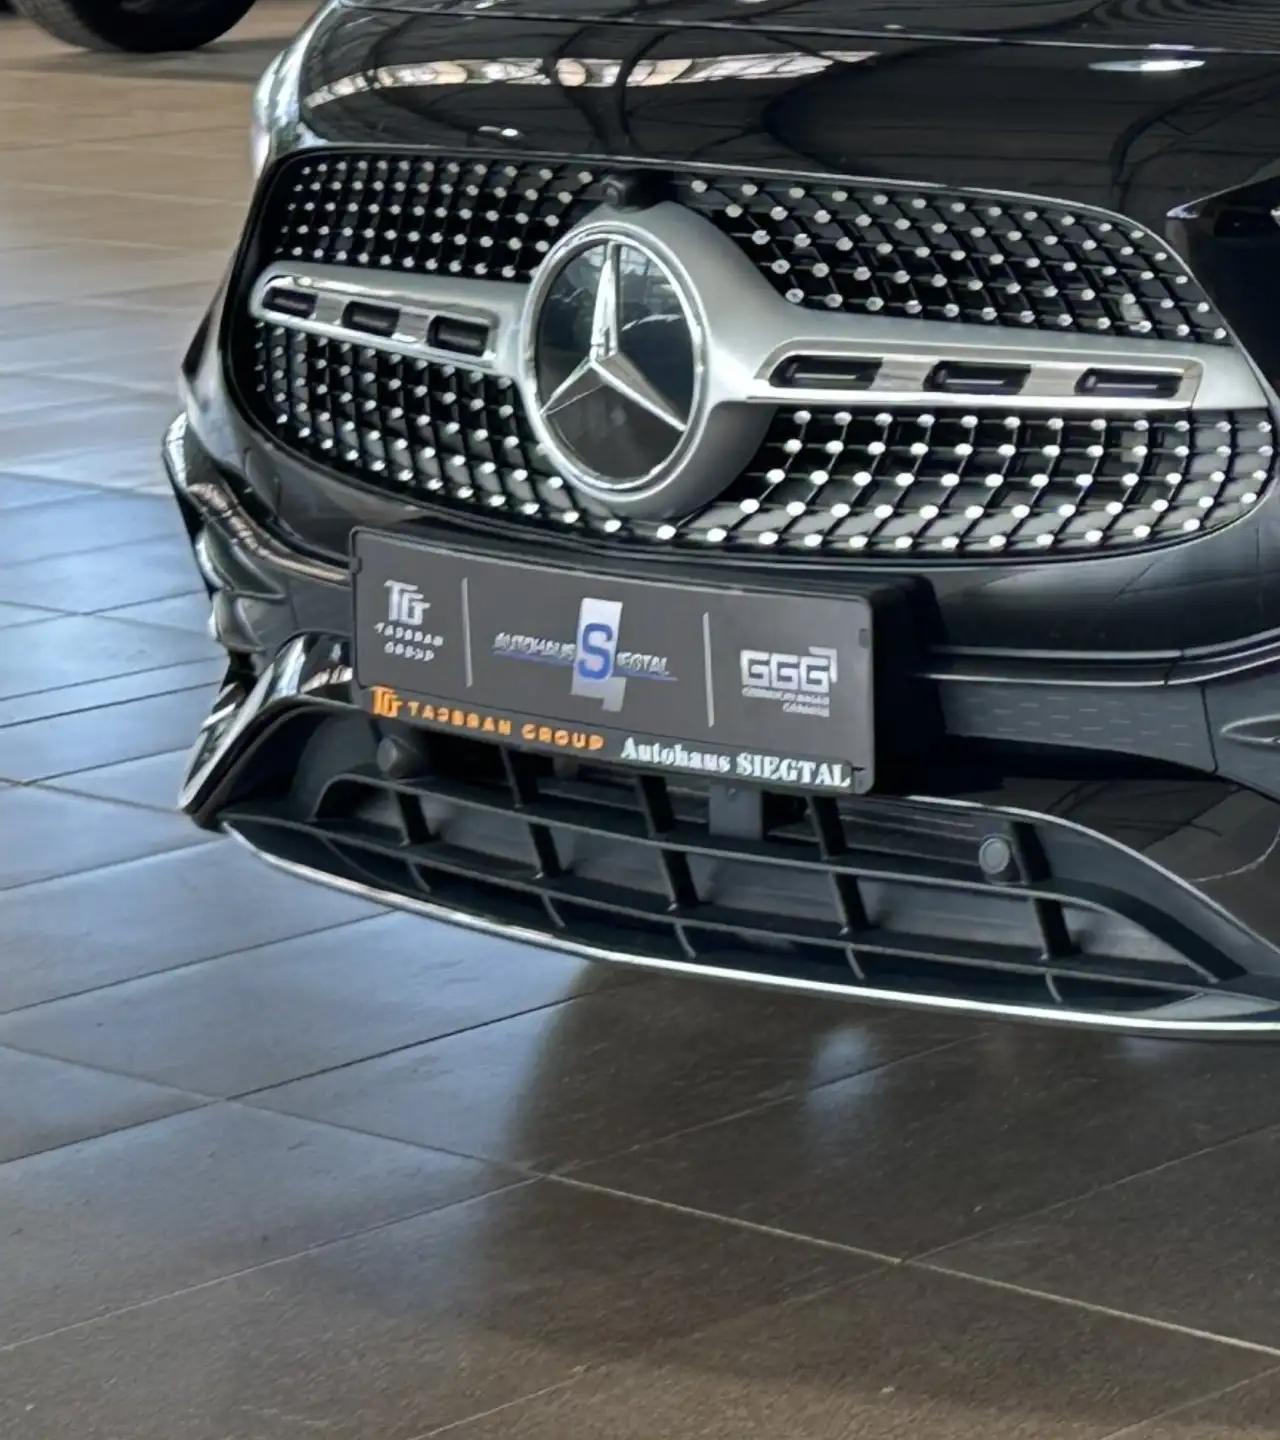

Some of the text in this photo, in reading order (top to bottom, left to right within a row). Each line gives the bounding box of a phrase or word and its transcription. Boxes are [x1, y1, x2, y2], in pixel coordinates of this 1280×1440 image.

[521, 723, 605, 751] GROUP
[620, 736, 852, 789] Autohaus SIEGTAL
